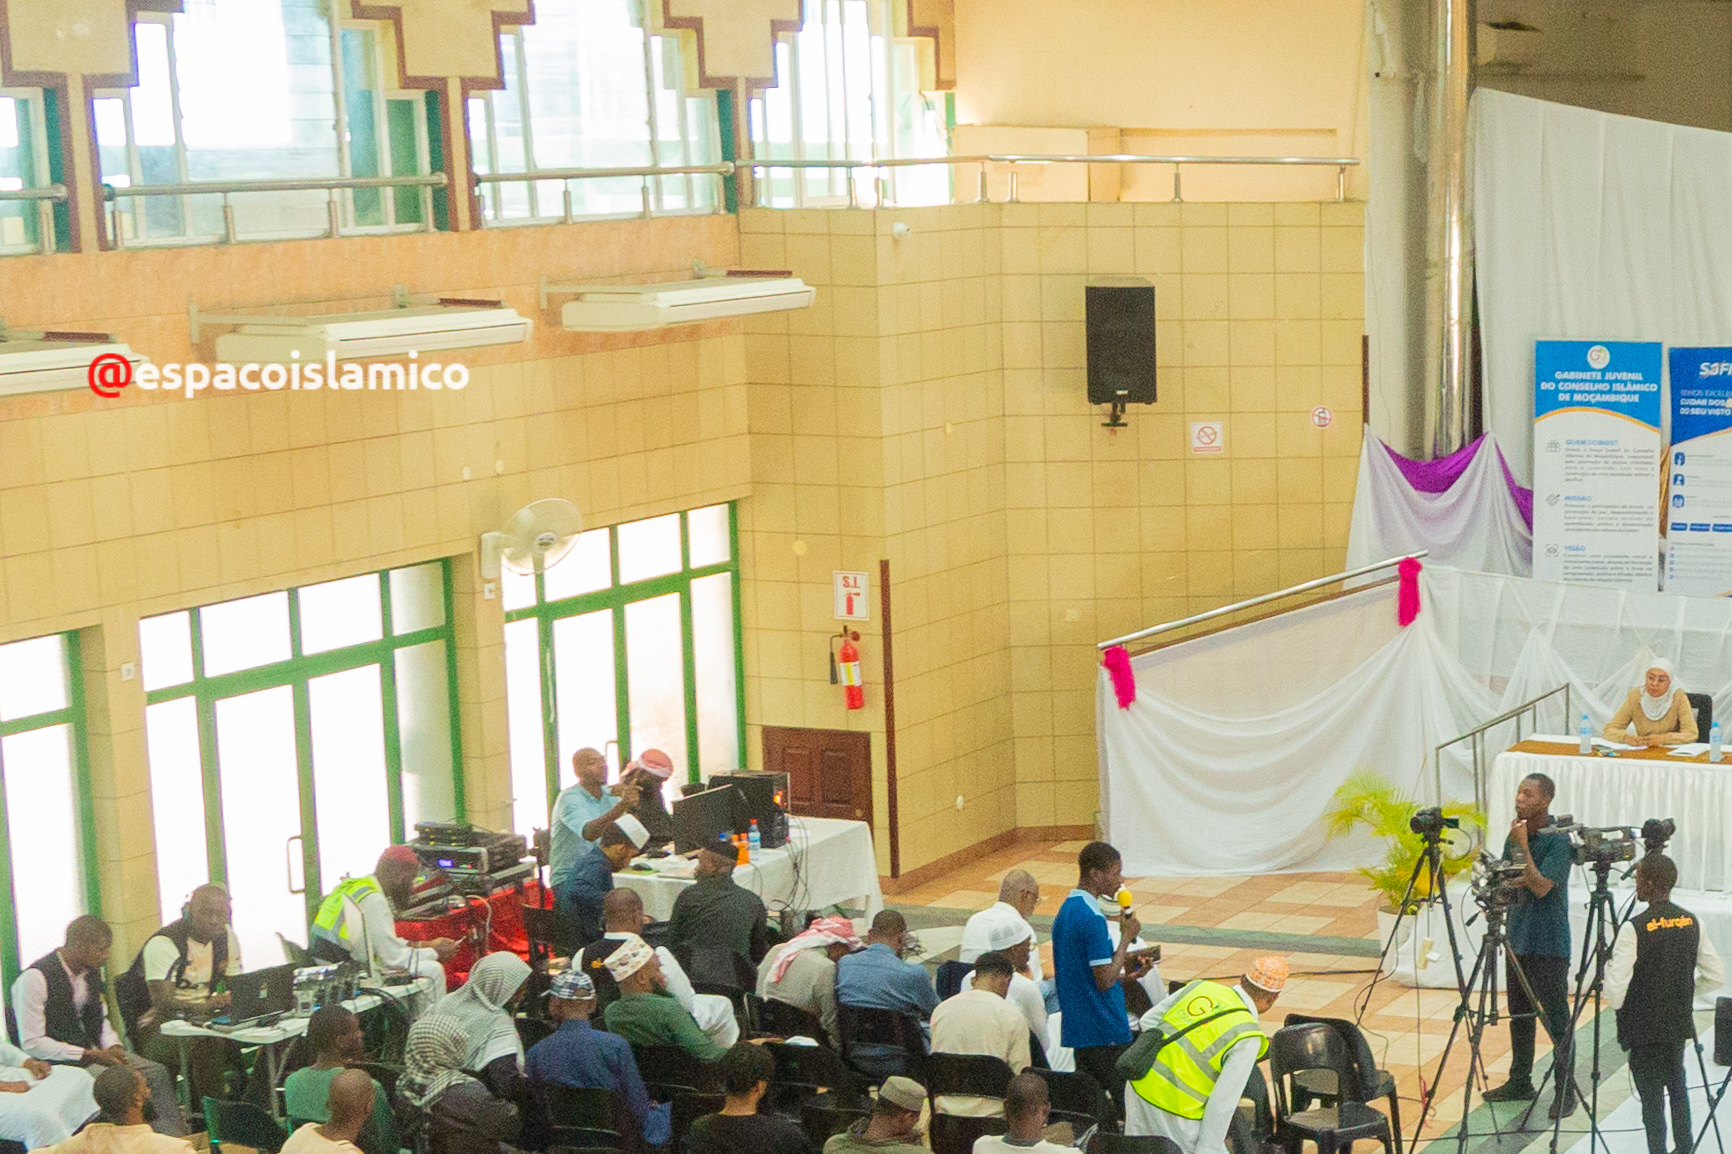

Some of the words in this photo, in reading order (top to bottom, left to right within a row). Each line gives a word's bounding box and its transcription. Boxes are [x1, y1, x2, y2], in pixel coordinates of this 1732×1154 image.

[1555, 371, 1602, 380] GABINETE
[1604, 372, 1643, 380] JUVENIL
[1541, 382, 1555, 390] DO
[1558, 382, 1610, 391] CONSELHO
[1612, 381, 1658, 391] ISLÂMICO
[1558, 393, 1570, 401] DE
[1573, 393, 1640, 403] MOÇAMBIQUE
